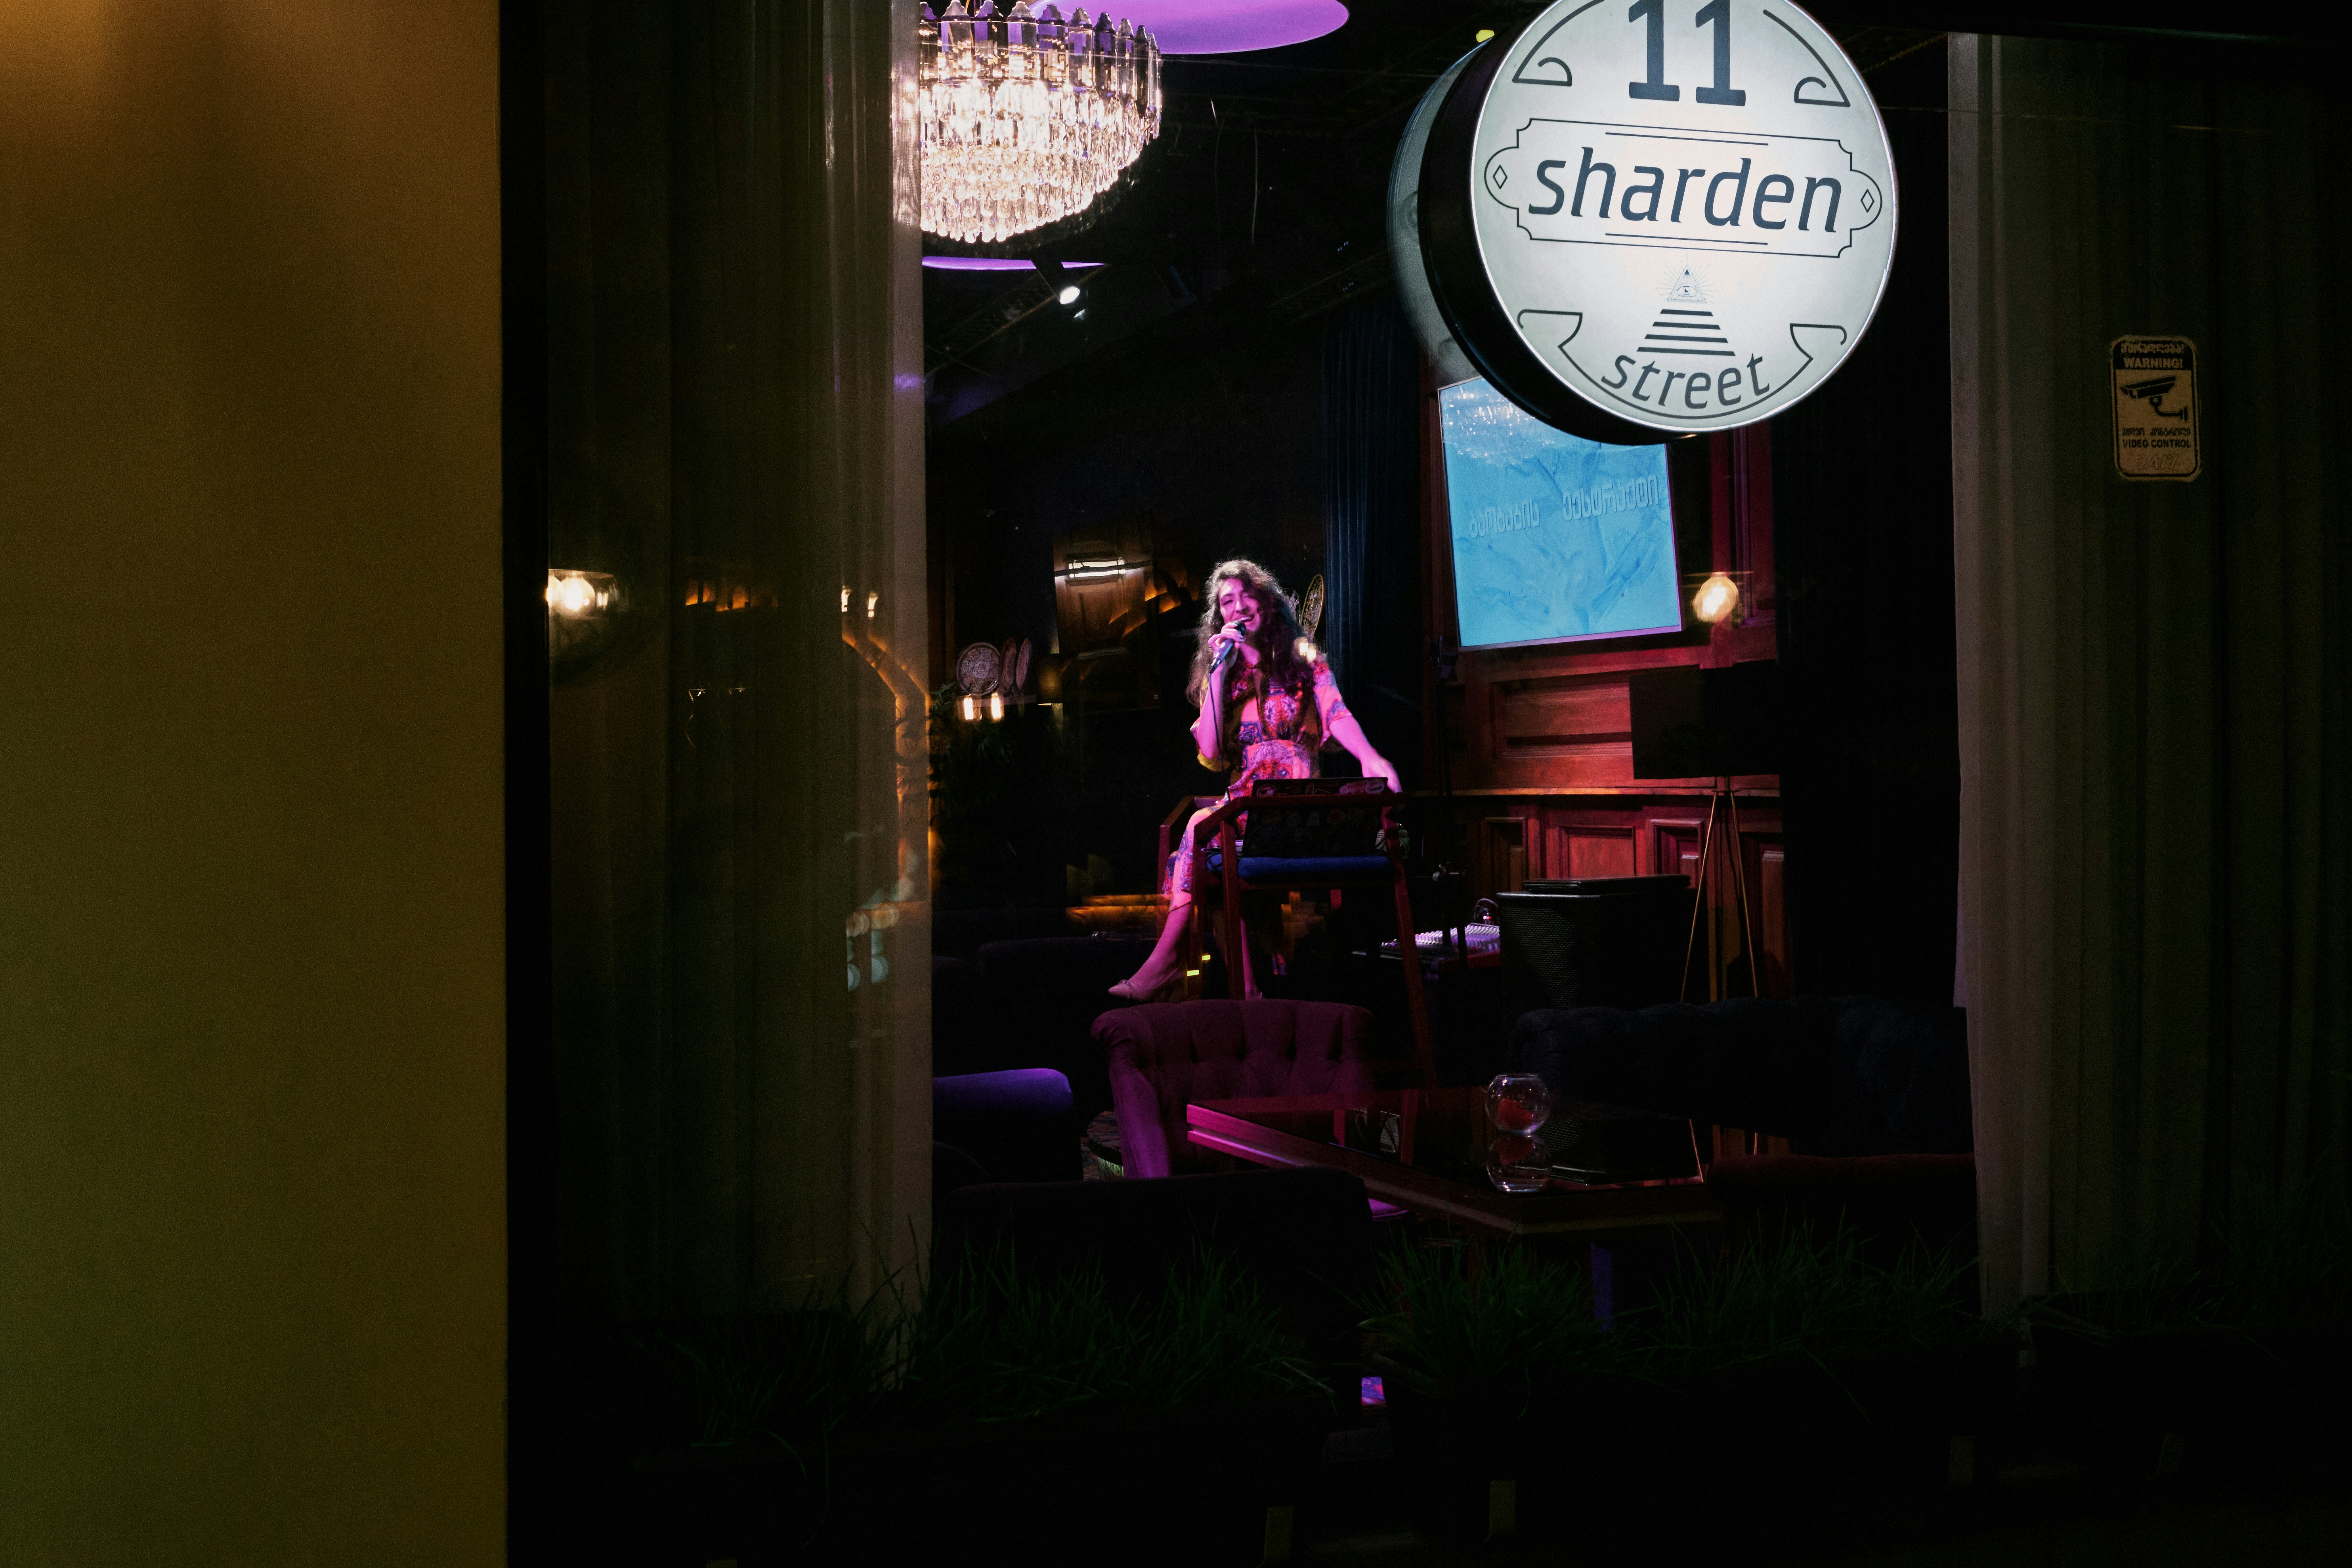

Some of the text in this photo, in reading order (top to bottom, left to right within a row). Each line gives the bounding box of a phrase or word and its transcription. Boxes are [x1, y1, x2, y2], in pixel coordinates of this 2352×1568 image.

[1628, 0, 1746, 106] 11
[1529, 147, 1842, 233] sharden
[1601, 353, 1770, 409] street
[2123, 357, 2183, 368] WARNING!
[2122, 439, 2191, 448] VIDEO CONTROL
